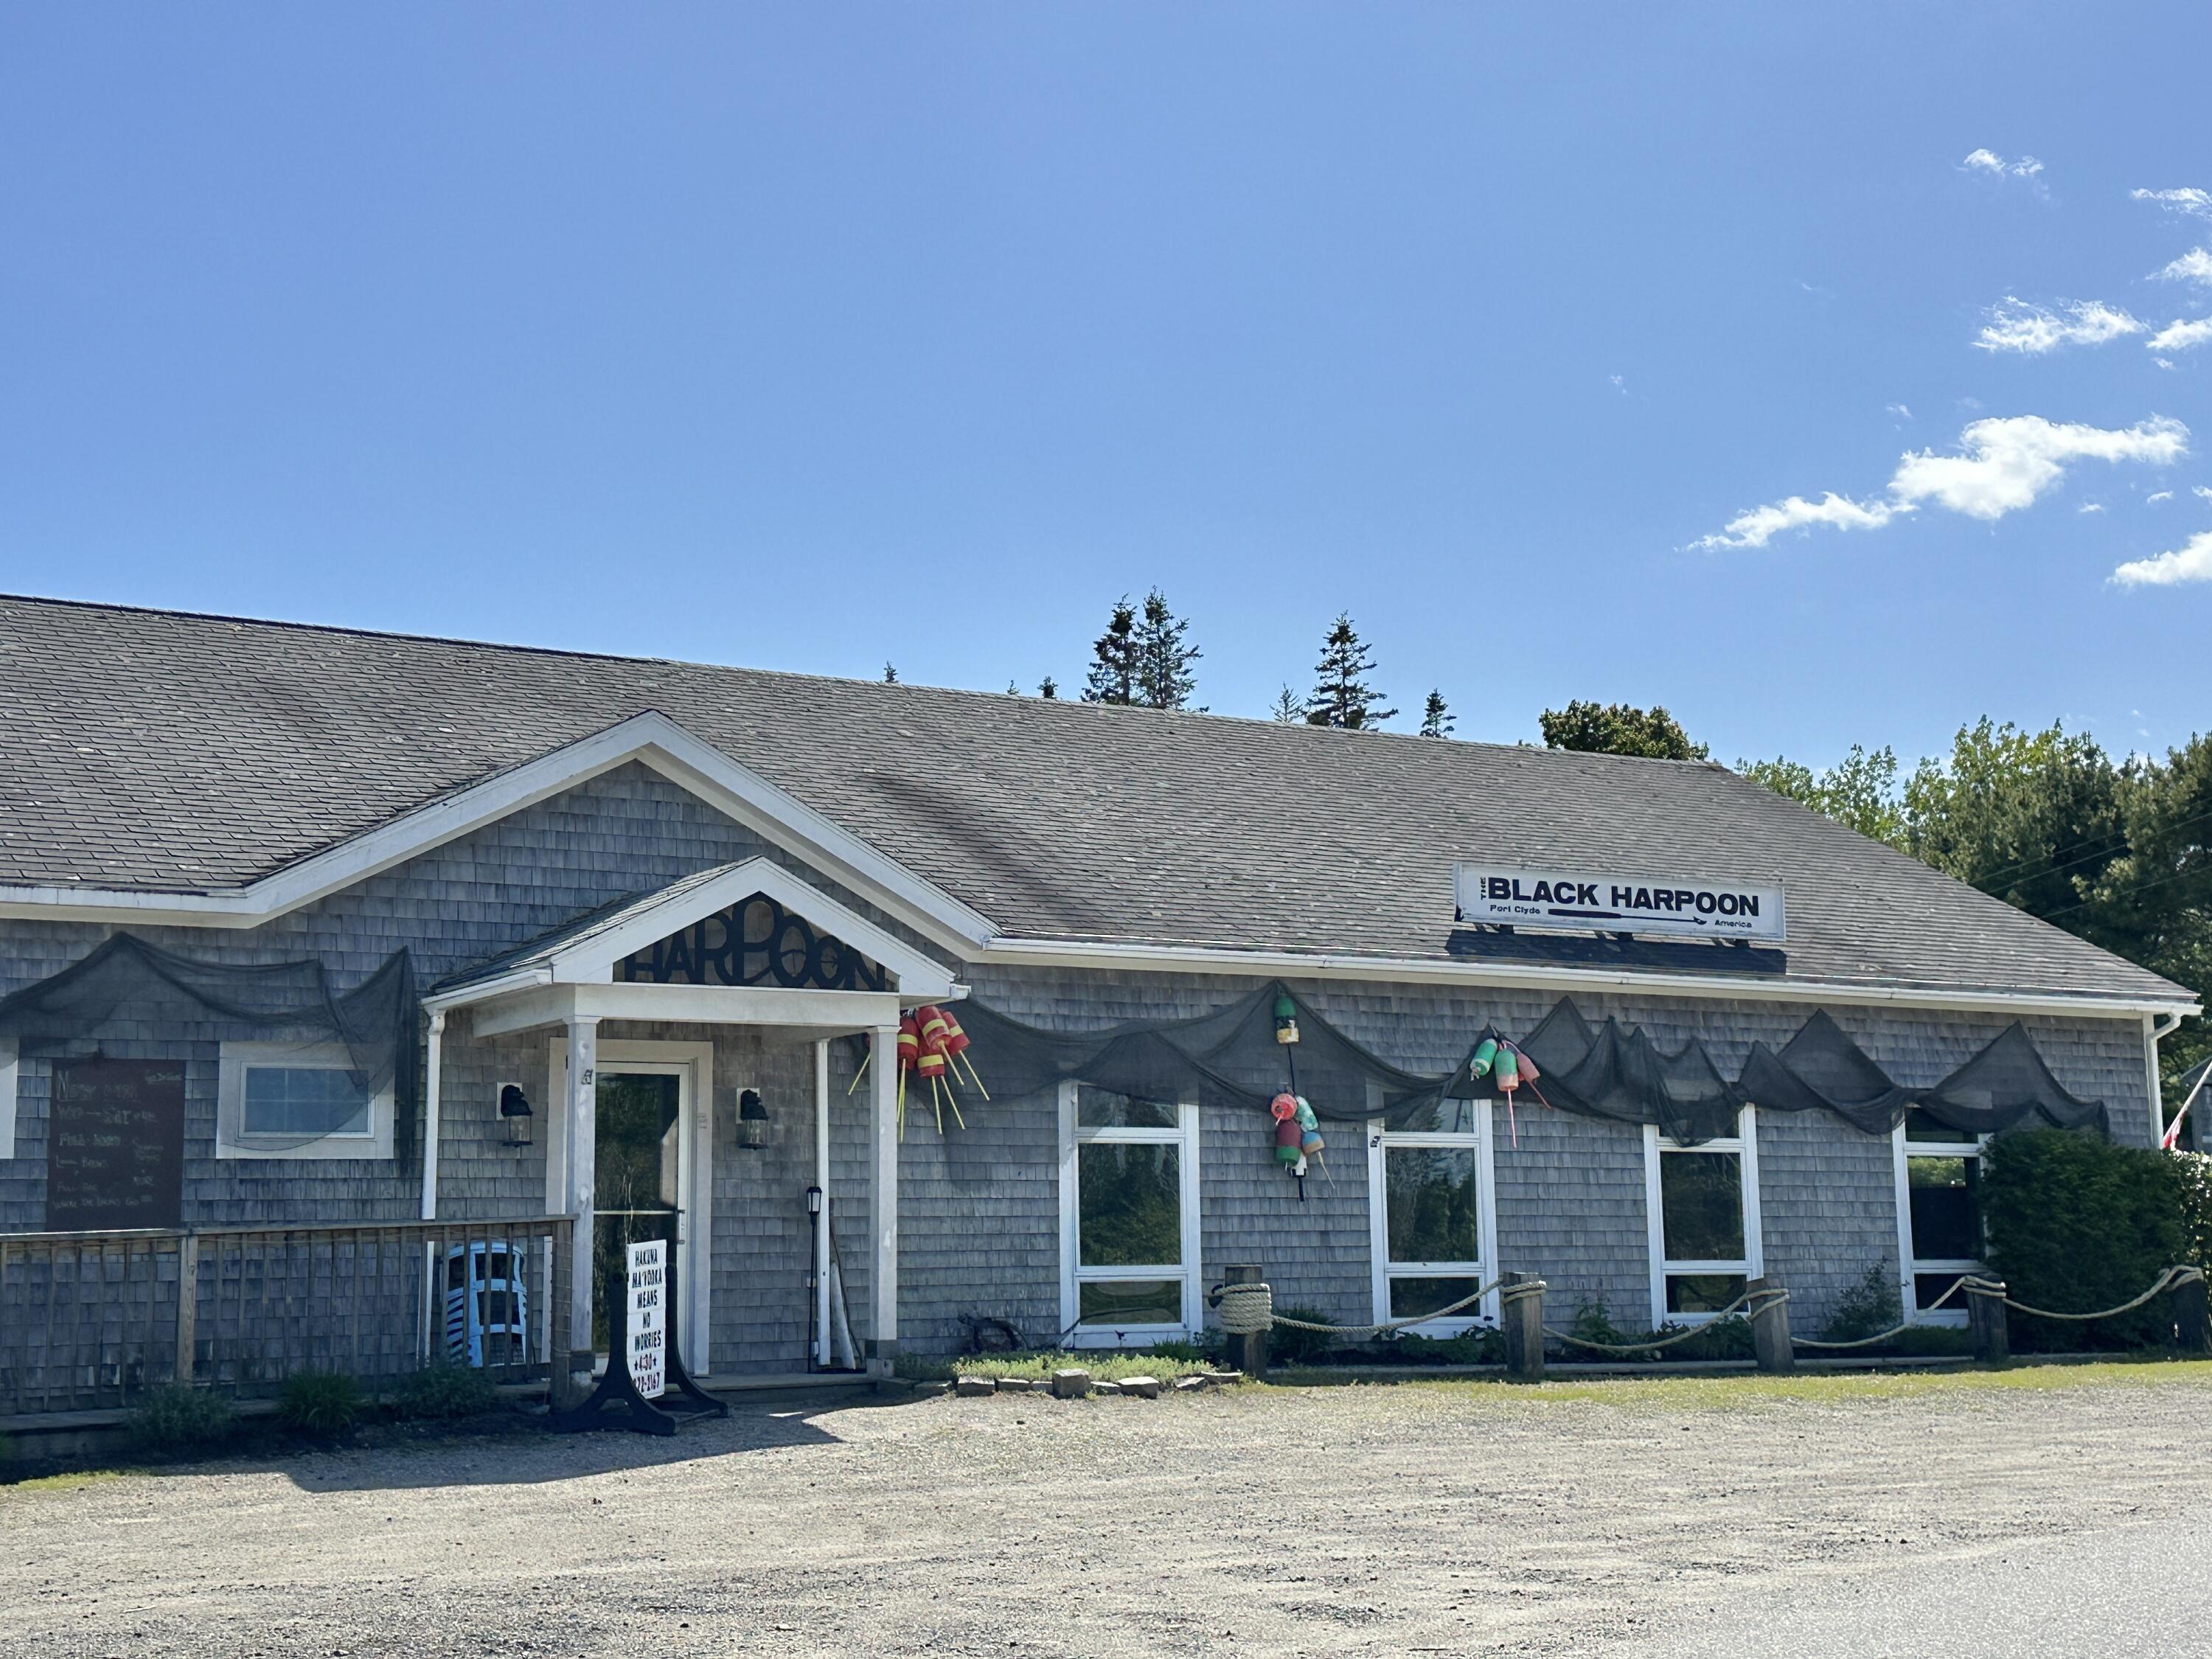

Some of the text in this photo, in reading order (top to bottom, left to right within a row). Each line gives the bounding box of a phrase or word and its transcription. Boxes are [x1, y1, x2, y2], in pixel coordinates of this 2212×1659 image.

[1488, 877, 1759, 917] BLACK HARPOON
[1490, 904, 1753, 928] Port Clyde America
[625, 891, 886, 991] HARPOON
[635, 1248, 658, 1267] HAKUNA
[637, 1289, 658, 1309] MEANS
[642, 1312, 650, 1329] NO
[635, 1329, 661, 1352] WORRIES
